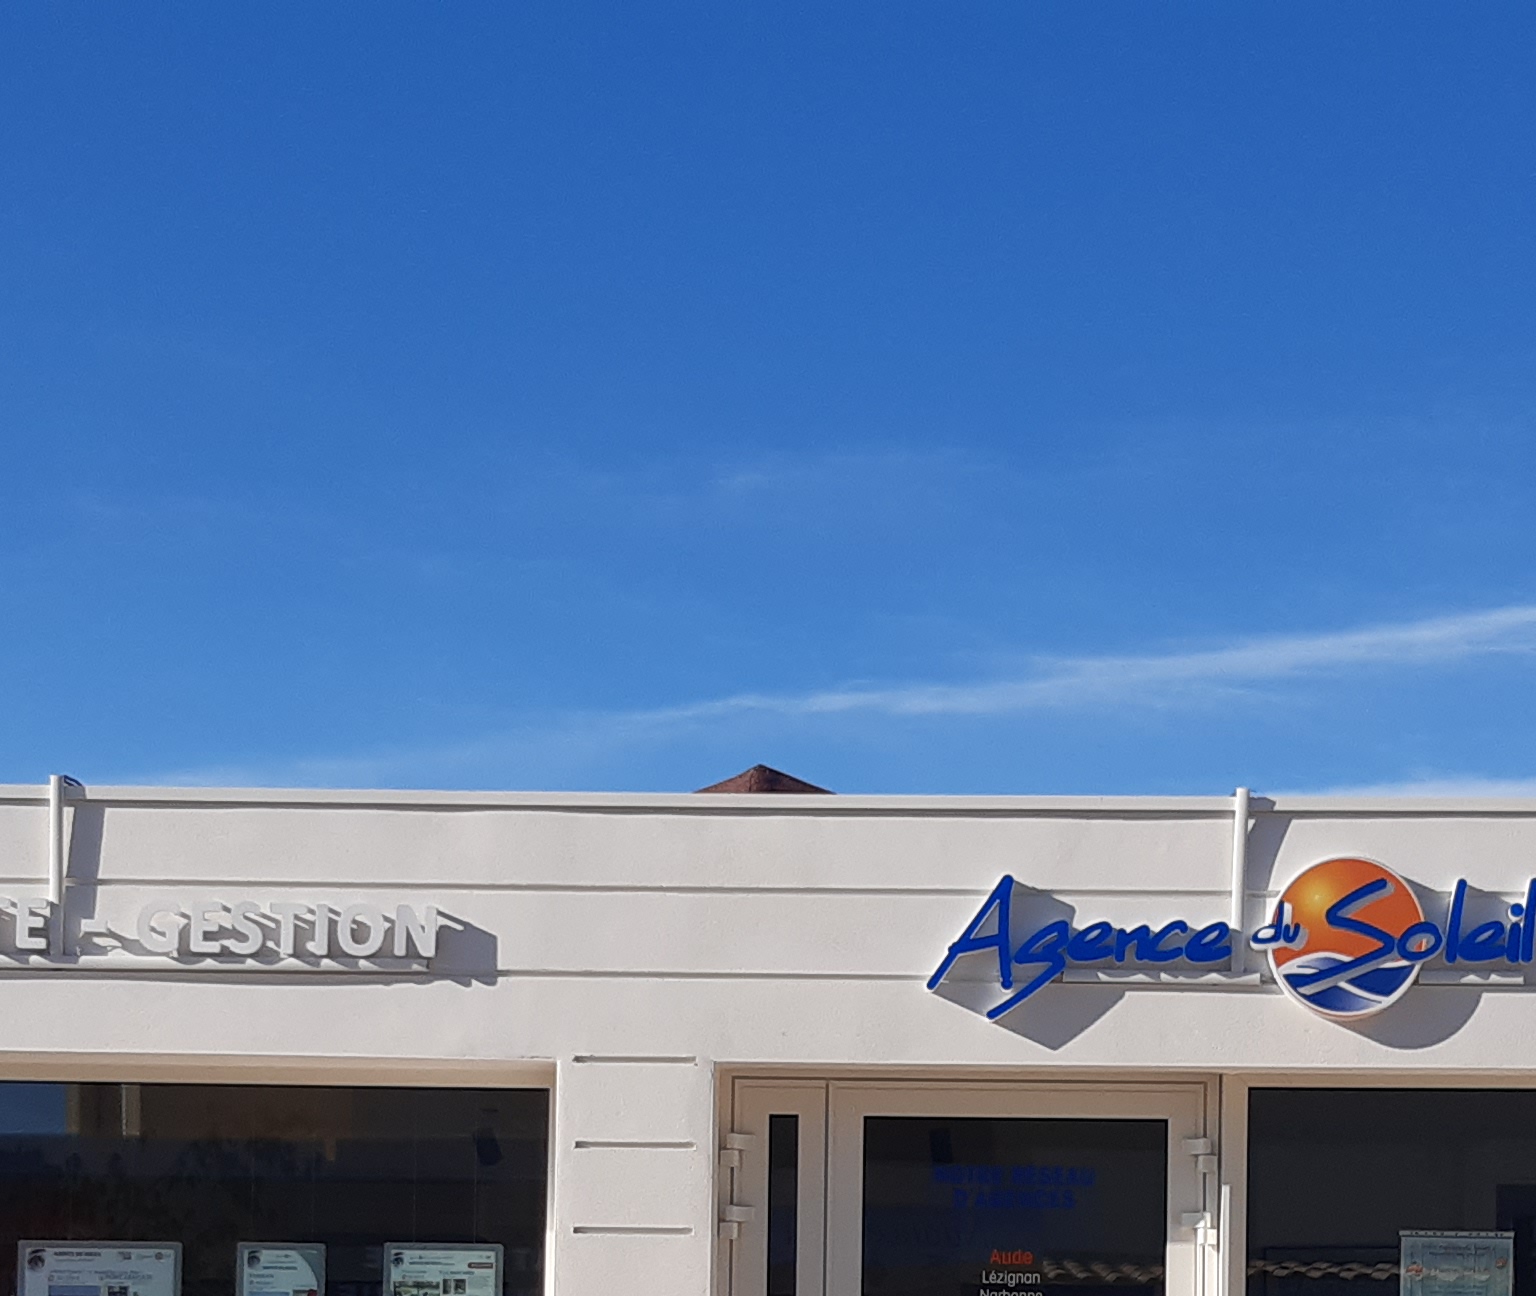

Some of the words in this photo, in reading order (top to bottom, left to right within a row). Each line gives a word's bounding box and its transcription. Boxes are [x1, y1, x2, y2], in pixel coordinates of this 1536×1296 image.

[136, 902, 442, 960] GESTION
[927, 873, 1232, 1023] Agence
[1250, 900, 1302, 952] du
[990, 1249, 1033, 1265] Aude
[982, 1270, 1041, 1287] Lézignan
